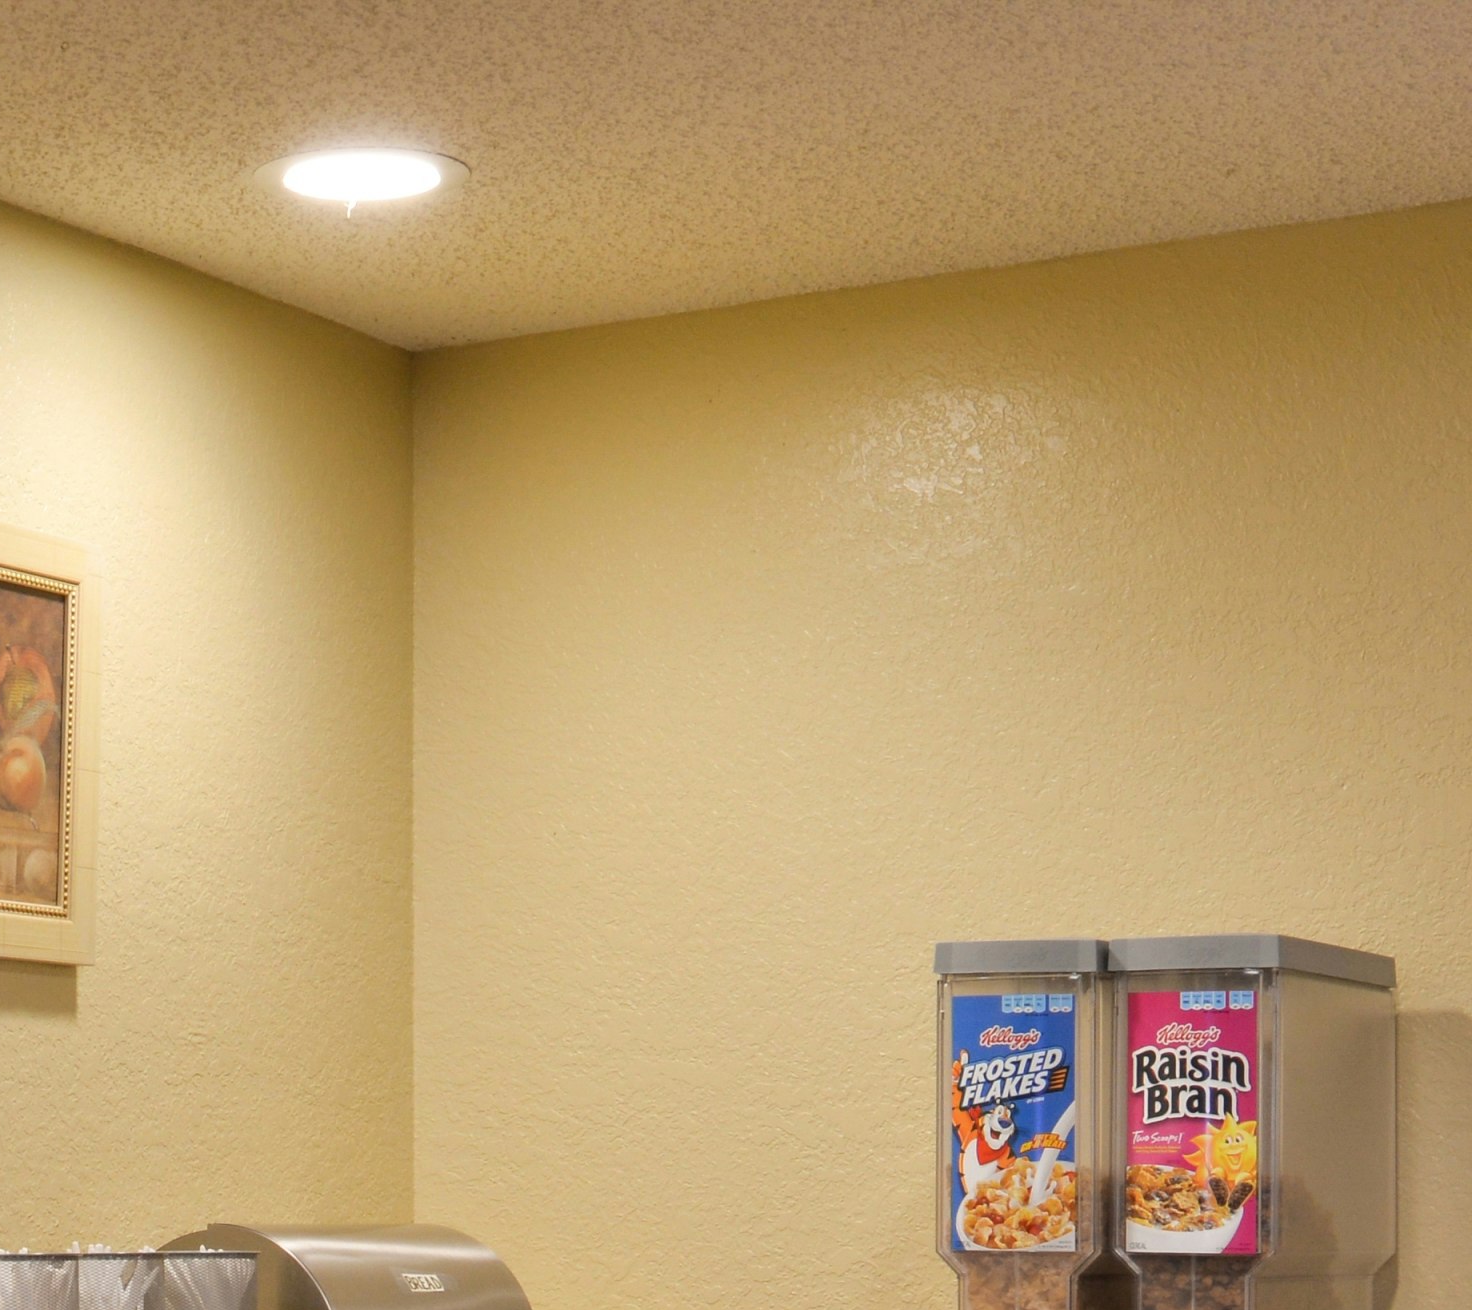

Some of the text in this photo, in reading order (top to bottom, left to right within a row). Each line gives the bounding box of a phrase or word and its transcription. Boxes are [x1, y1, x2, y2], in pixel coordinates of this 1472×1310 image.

[980, 1025, 1041, 1049] Kellogg's
[1157, 1022, 1221, 1047] Kellogg's
[960, 1048, 1063, 1088] FROSTED
[1134, 1048, 1248, 1090] Raisin
[961, 1070, 1049, 1108] FLAKES
[1146, 1083, 1235, 1120] Bran
[404, 1275, 443, 1290] BREAD
